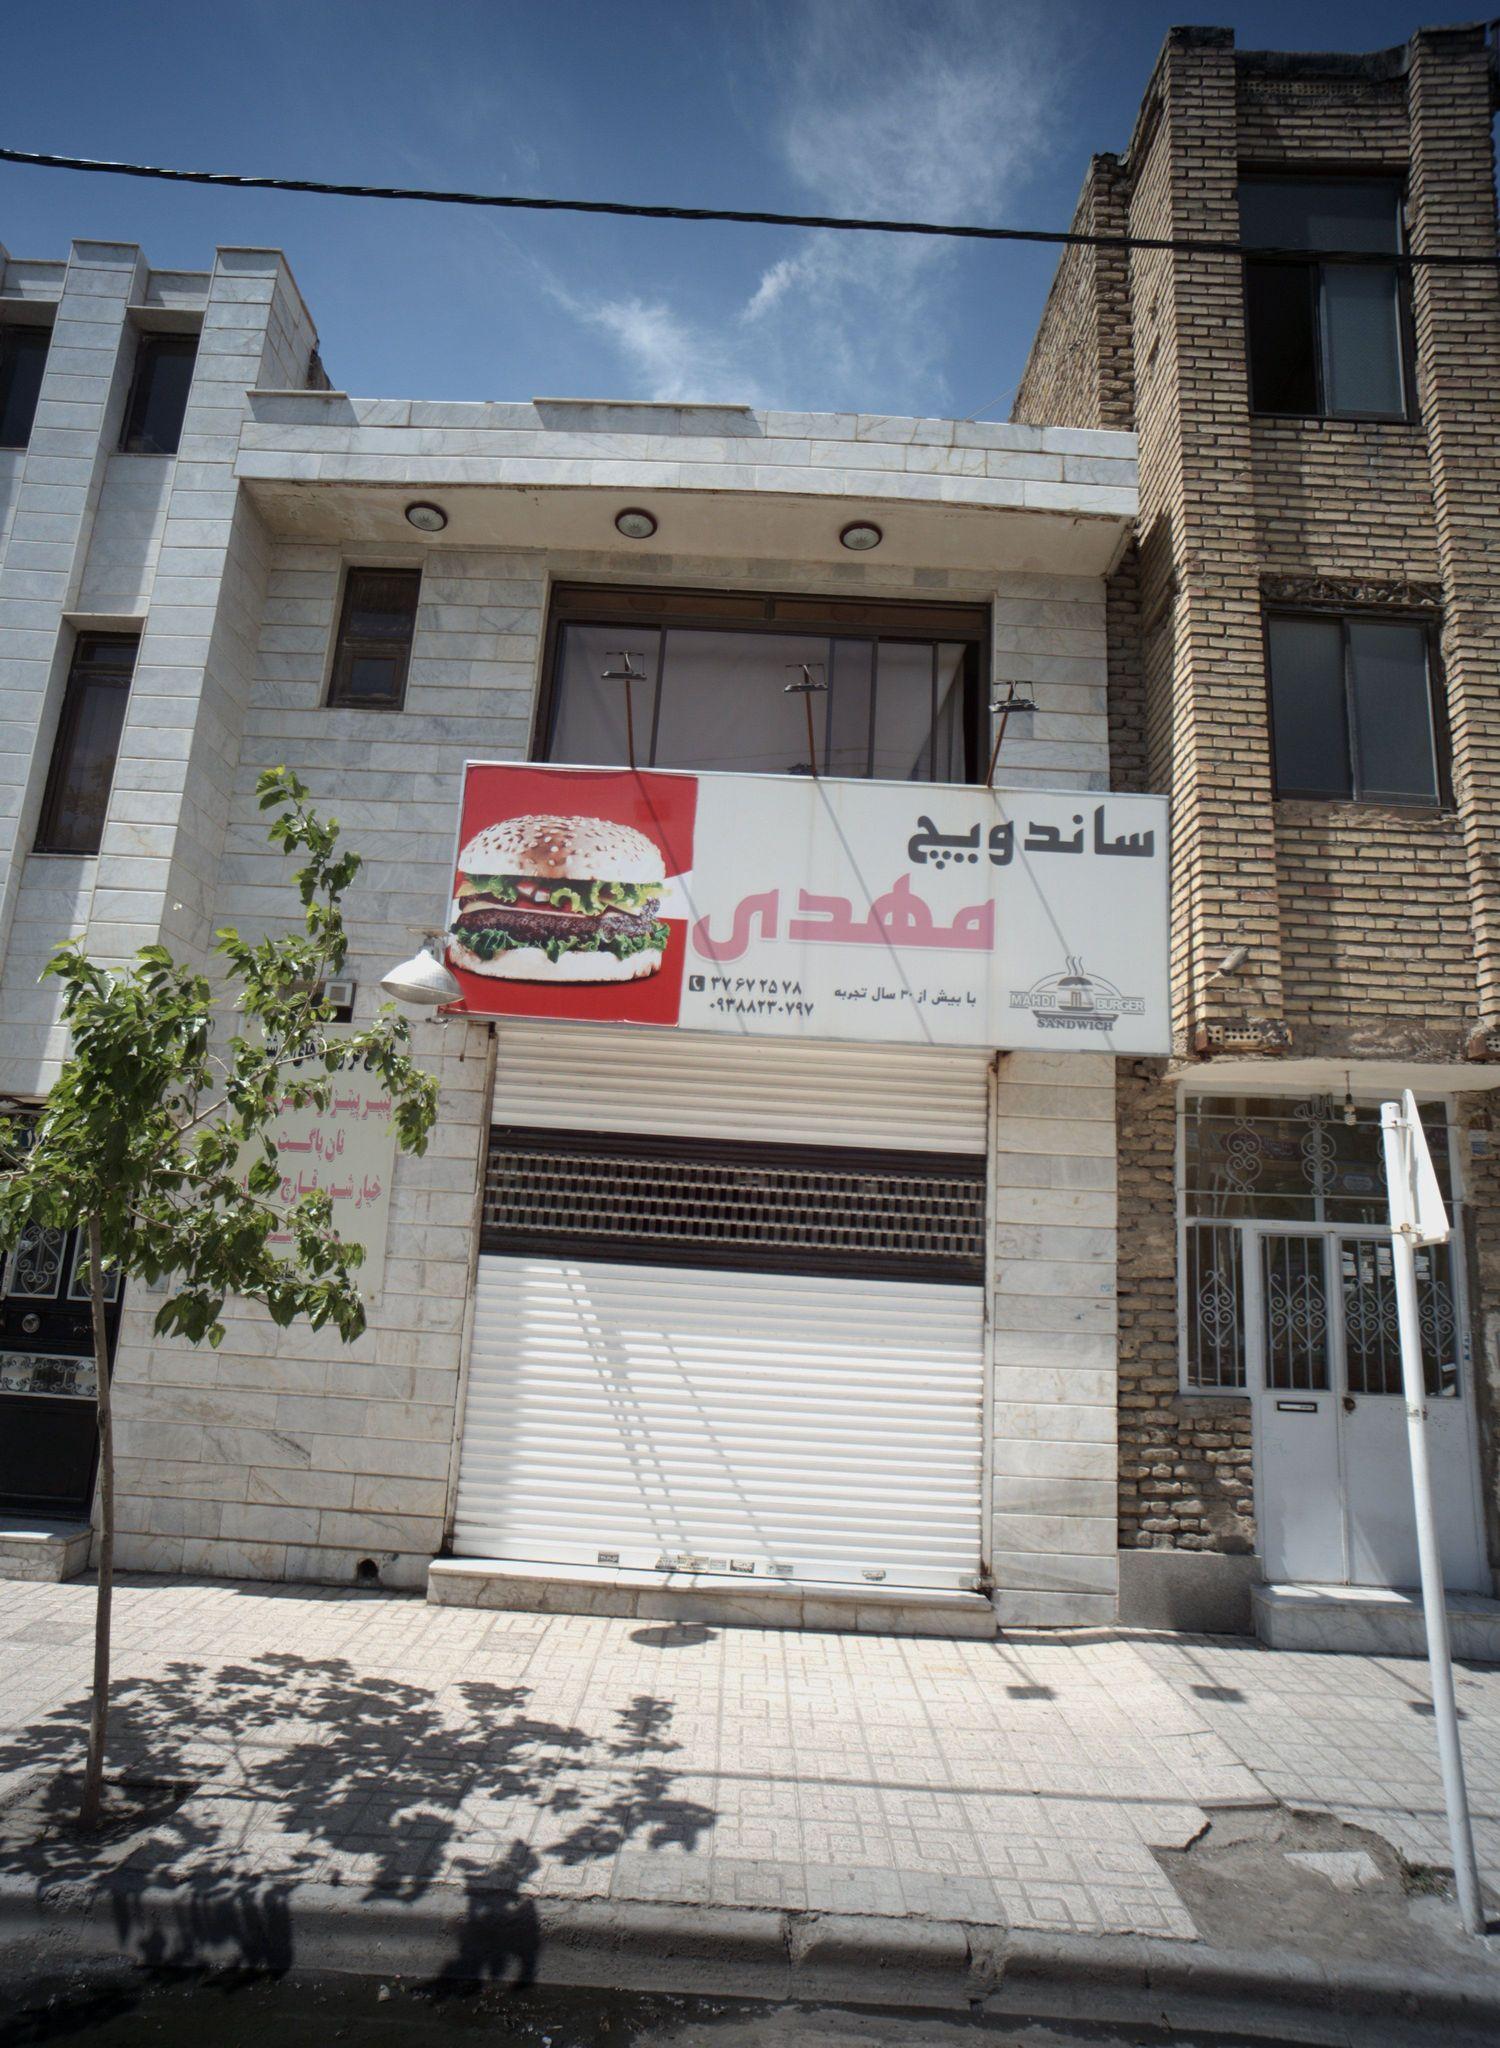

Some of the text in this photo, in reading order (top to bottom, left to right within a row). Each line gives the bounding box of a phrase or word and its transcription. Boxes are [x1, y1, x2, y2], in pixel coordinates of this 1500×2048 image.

[907, 805, 1154, 870] ساندویچ
[692, 873, 995, 962] مهدی
[834, 987, 868, 1001] تجربه
[871, 987, 896, 1002] سال
[917, 989, 927, 1004] از
[931, 989, 961, 1006] بیش
[966, 991, 977, 1007] با
[1009, 993, 1146, 1013] MAHDI BURGER
[1037, 1018, 1114, 1032] SANDWICH
